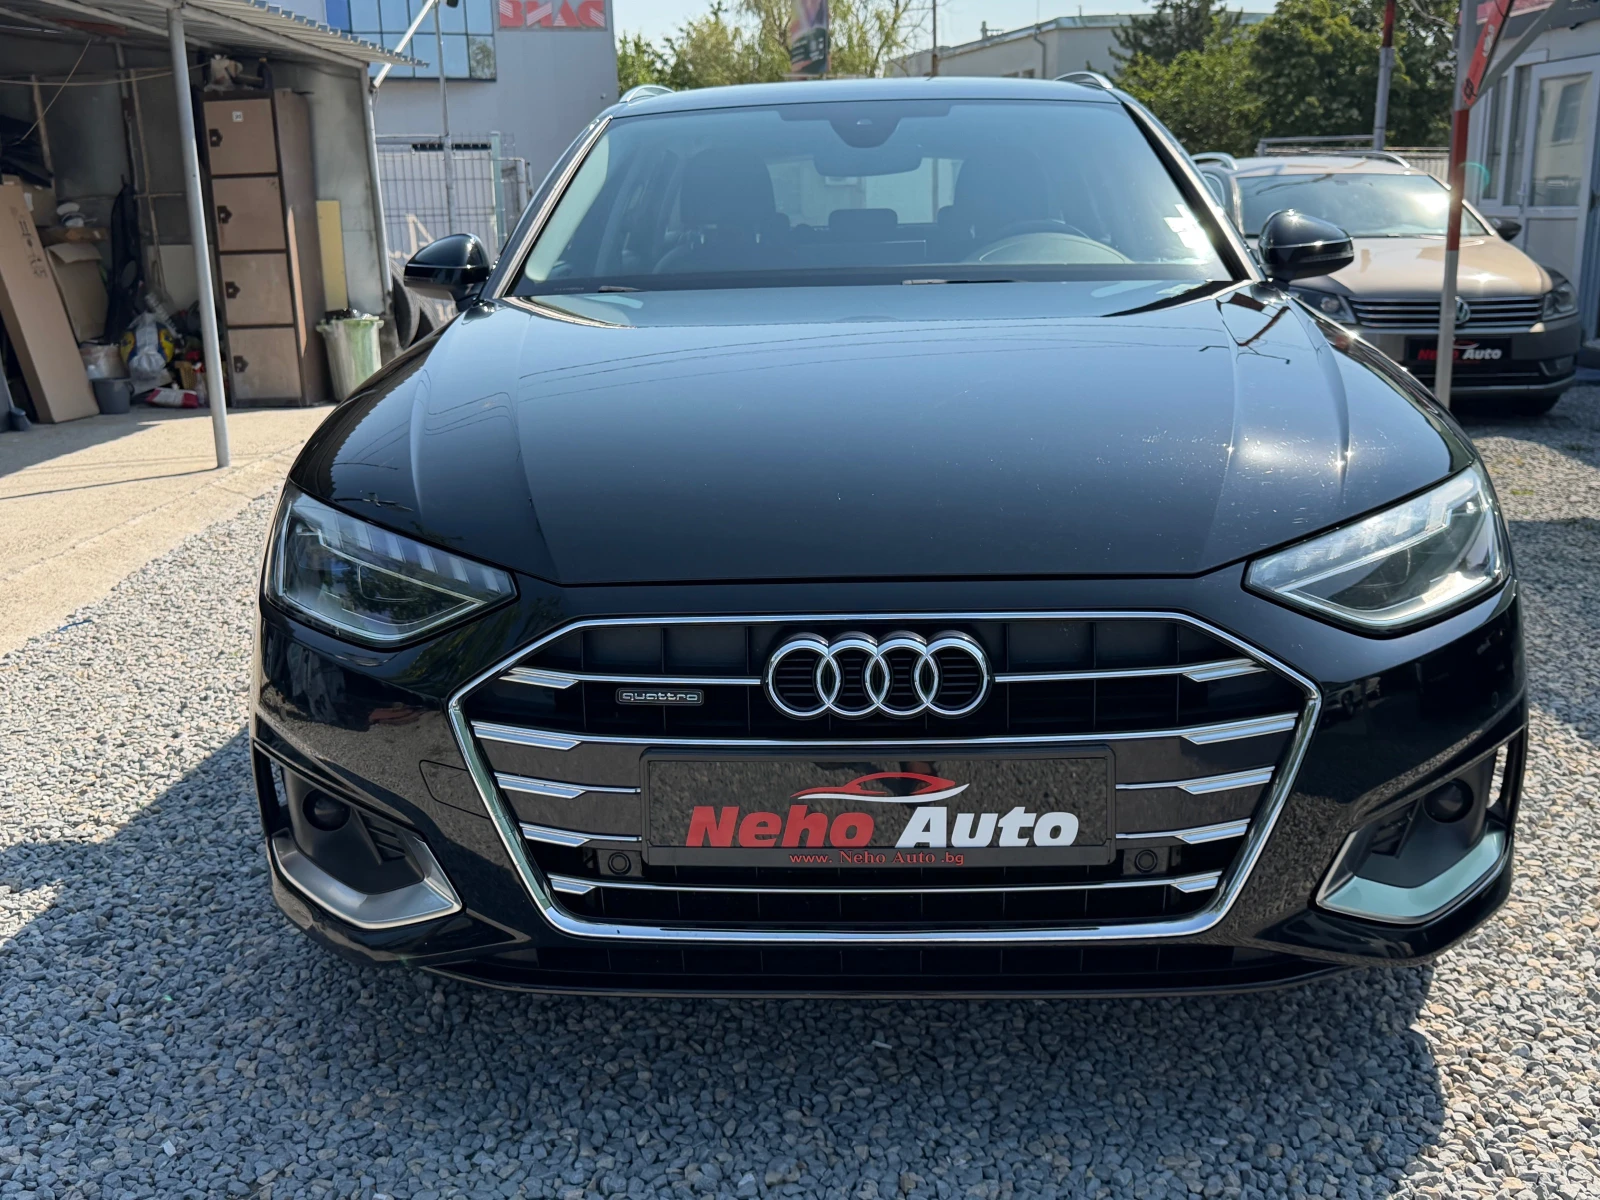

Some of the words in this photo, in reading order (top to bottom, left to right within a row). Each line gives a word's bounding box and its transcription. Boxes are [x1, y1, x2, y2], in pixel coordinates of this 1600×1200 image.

[1462, 348, 1502, 360] Auto
[622, 692, 698, 701] quattro
[685, 804, 875, 848] Neho
[895, 806, 1079, 848] Auto
[789, 854, 833, 863] www.
[839, 850, 886, 864] Neho
[892, 851, 936, 864] Auto
[941, 852, 965, 865] .bg
